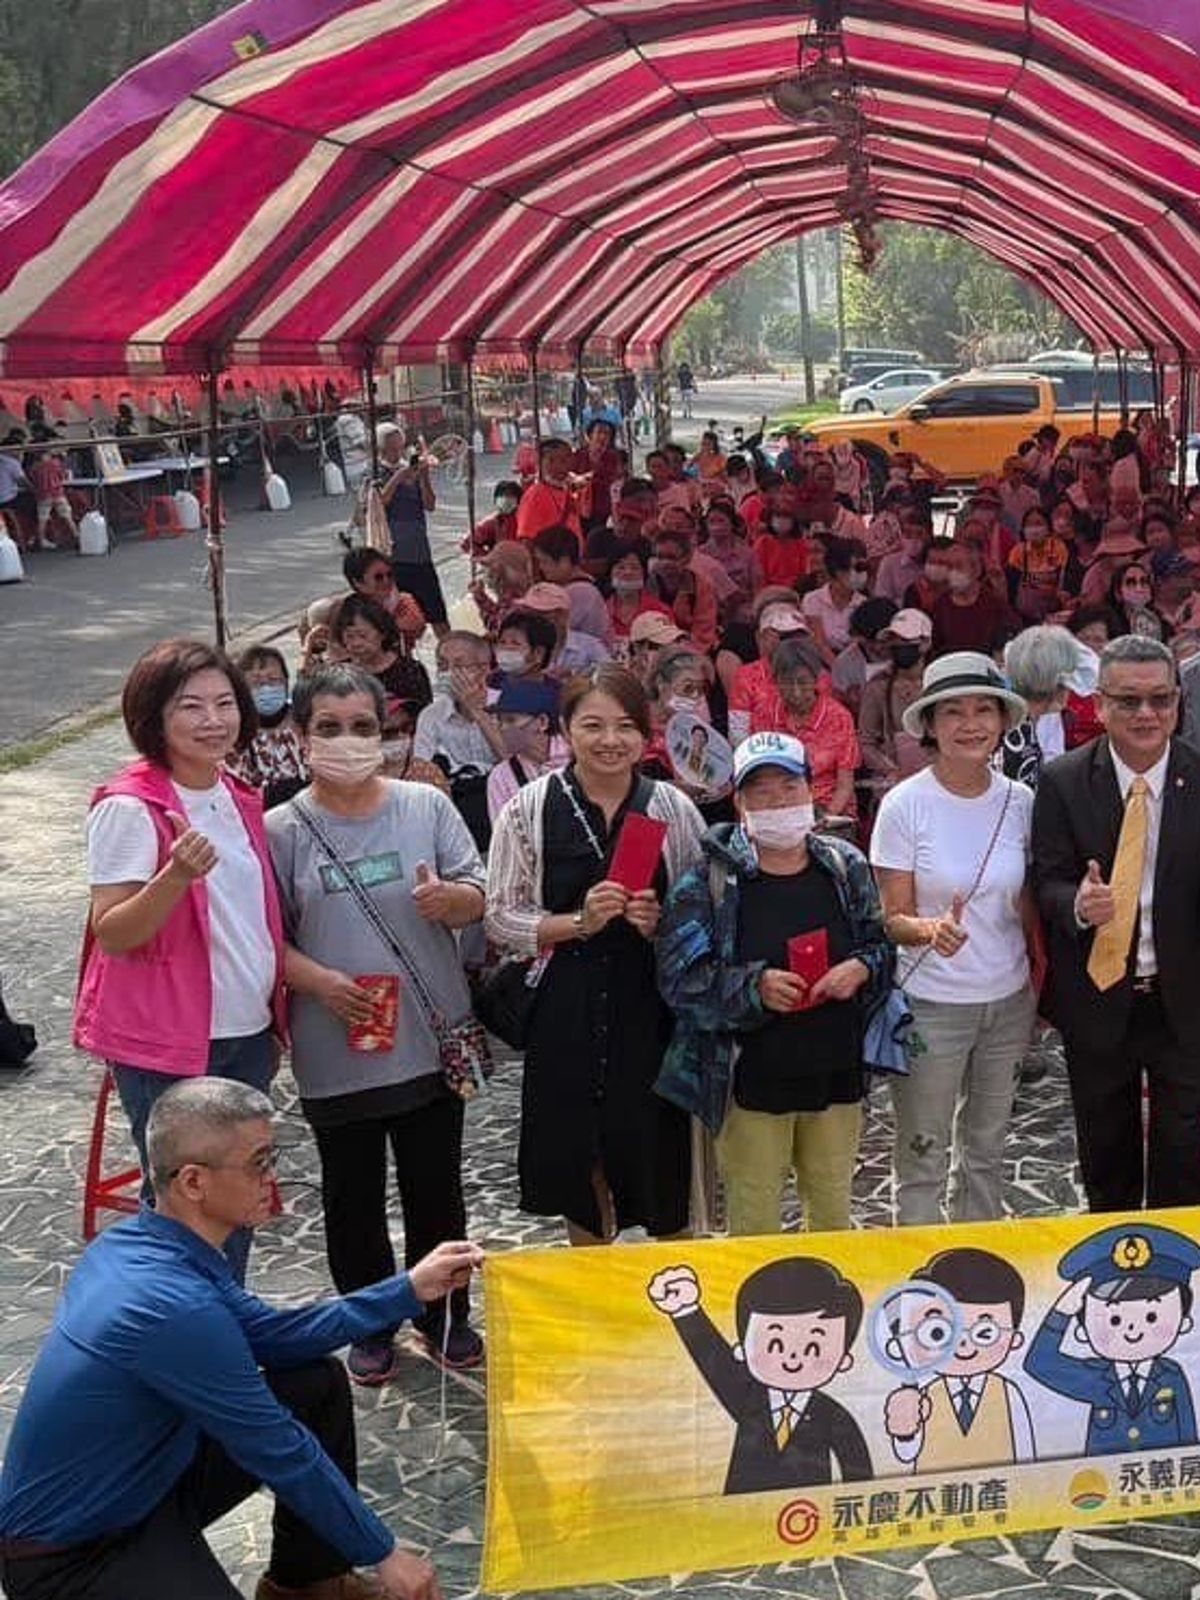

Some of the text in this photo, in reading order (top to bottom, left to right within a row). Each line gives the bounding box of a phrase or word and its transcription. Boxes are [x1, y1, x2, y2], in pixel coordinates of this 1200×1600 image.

[832, 1478, 1008, 1529] 永慶不動產
